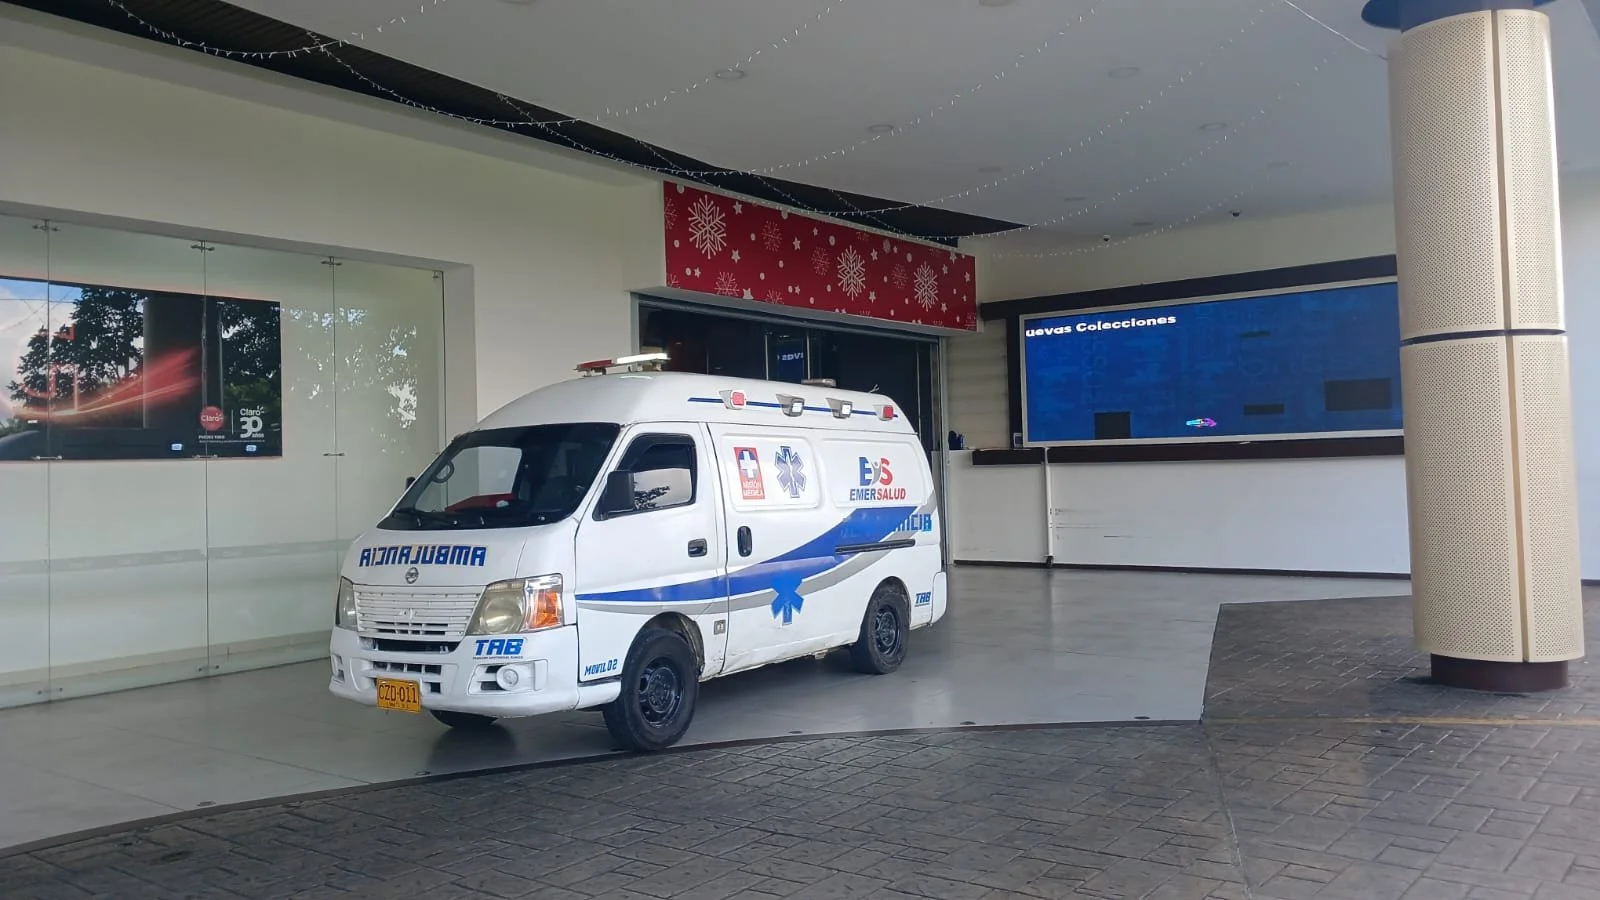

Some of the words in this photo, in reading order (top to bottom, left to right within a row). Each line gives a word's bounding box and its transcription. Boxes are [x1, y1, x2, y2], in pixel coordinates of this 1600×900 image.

[1025, 325, 1072, 337] uevas
[1076, 315, 1177, 332] Colecciones
[201, 414, 219, 422] Claro
[240, 408, 261, 416] Claro
[240, 416, 263, 439] 30
[849, 487, 907, 501] EMERSALUD
[916, 591, 932, 604] TAB
[475, 638, 524, 656] TAB
[379, 684, 417, 704] CZD-011
